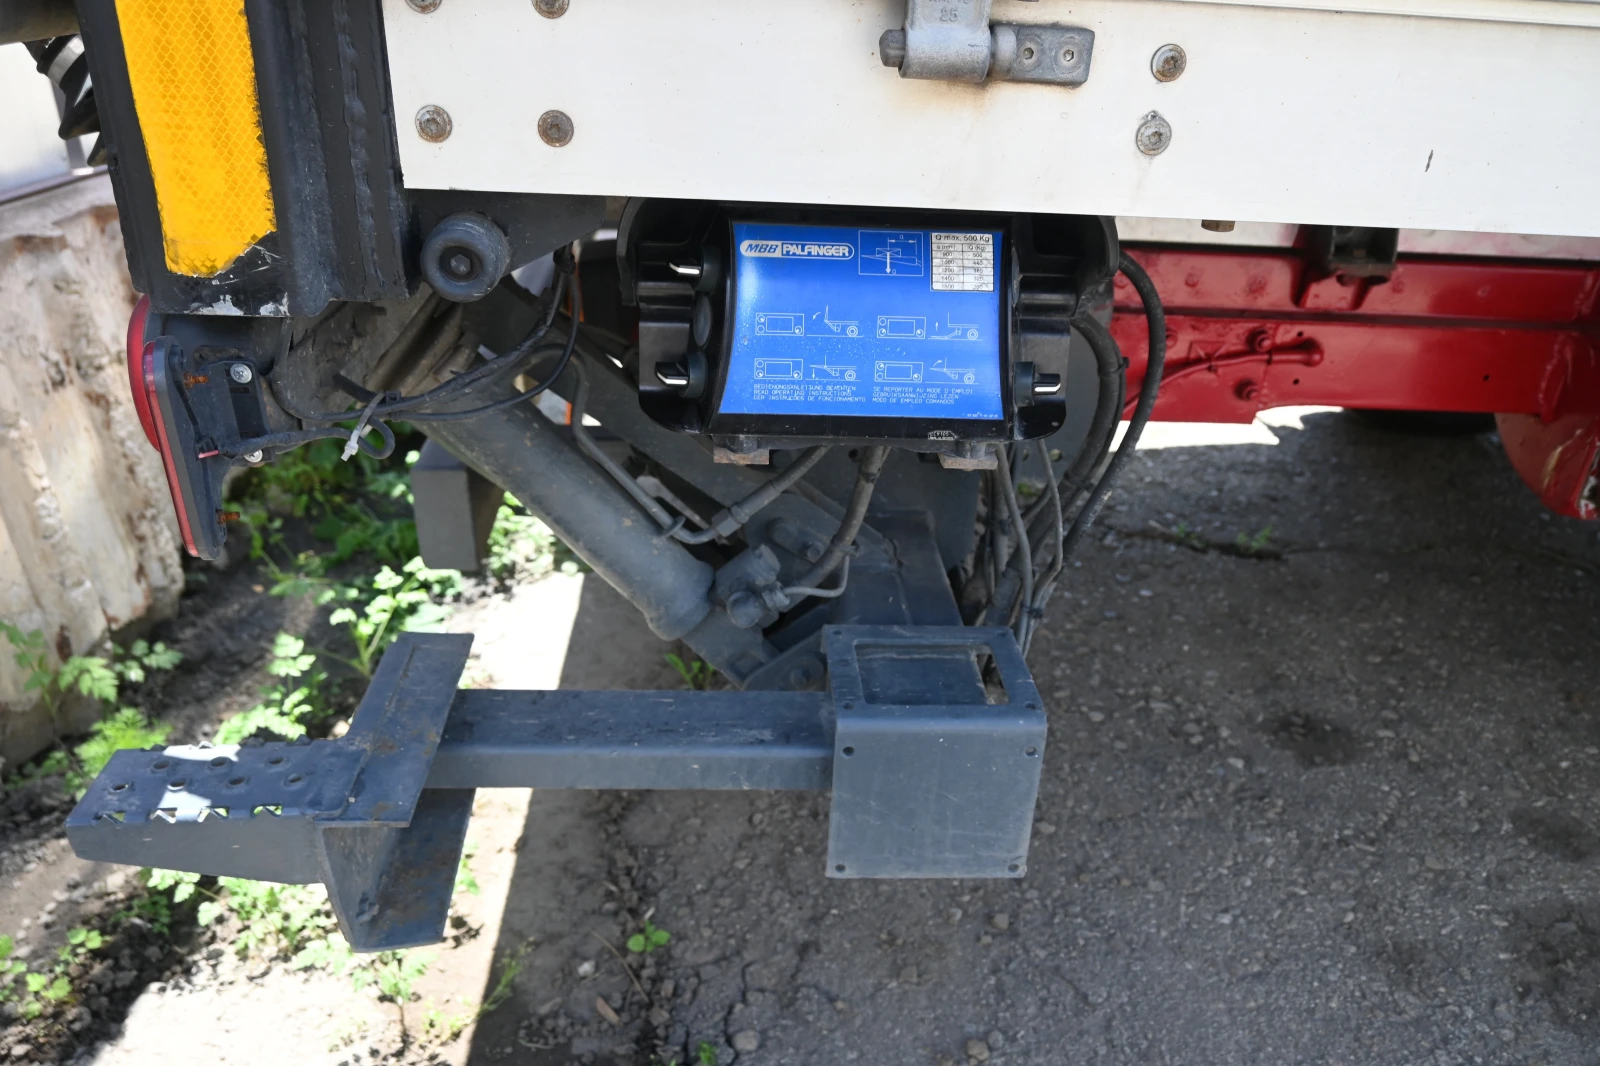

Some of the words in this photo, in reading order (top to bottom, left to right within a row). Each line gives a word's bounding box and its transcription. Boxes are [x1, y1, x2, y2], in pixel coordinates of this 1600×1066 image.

[979, 235, 990, 243] Kg
[744, 244, 779, 254] MBB
[782, 244, 850, 256] PALFINGER
